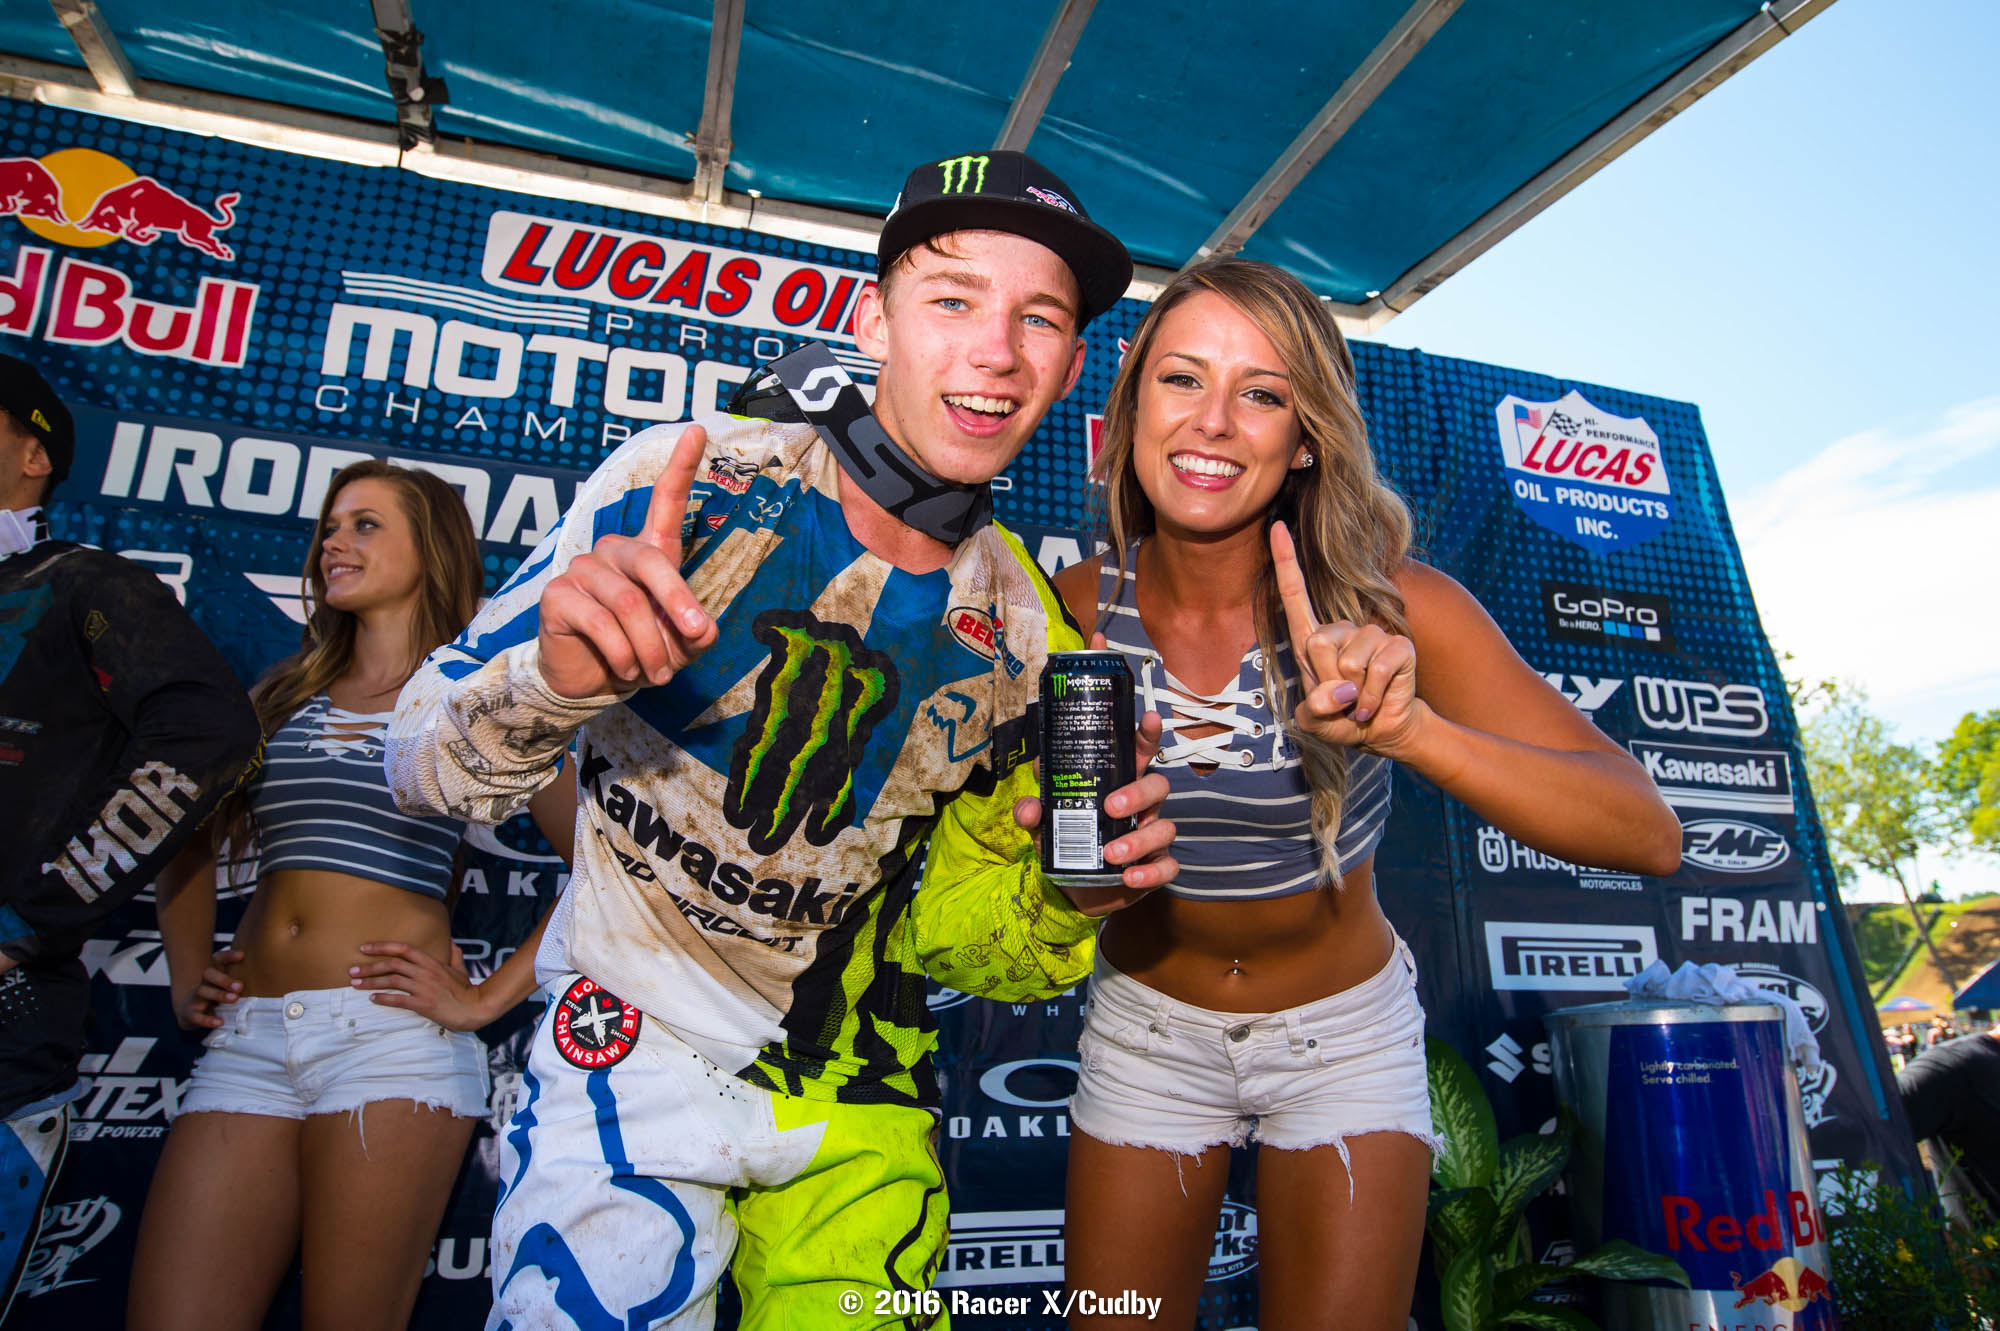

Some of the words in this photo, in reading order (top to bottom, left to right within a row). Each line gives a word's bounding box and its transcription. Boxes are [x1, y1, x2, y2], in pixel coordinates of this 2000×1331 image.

[500, 222, 762, 318] LUCAS
[772, 266, 878, 335] OI
[44, 257, 260, 369] Bull
[605, 312, 786, 361] PRO
[321, 302, 757, 423] MOTOC
[1584, 417, 1599, 427] HI-
[1586, 429, 1657, 450] PERFORMANCE
[1522, 434, 1656, 486] LUCAS
[1514, 479, 1549, 503] OIL
[1555, 486, 1669, 520] PRODUCTS
[1575, 516, 1619, 540] INC.
[1553, 592, 1658, 626] GoPro
[1066, 677, 1112, 688] MONSTER
[1634, 675, 1770, 738] WPS
[1053, 772, 1082, 782] Unleash
[1056, 780, 1068, 788] the
[1641, 751, 1777, 788] Kawasaki
[41, 761, 200, 904] THOR
[579, 744, 860, 926] Kawasaki
[1682, 828, 1786, 858] FMF
[1579, 878, 1644, 892] MOTORCYCLES
[1681, 896, 1818, 945] FRAM
[565, 1000, 583, 1013] STEVIE
[558, 1011, 621, 1063] CHAINSAW
[610, 1028, 631, 1042] SMITH
[1640, 1060, 1674, 1075] Lightly
[1677, 1058, 1741, 1072] carbonated.
[1641, 1075, 1673, 1085] Serve
[98, 1126, 165, 1139] POWER
[949, 1115, 1072, 1139] OAKL
[1661, 1189, 1784, 1253] Red
[1228, 1261, 1245, 1272] KITS
